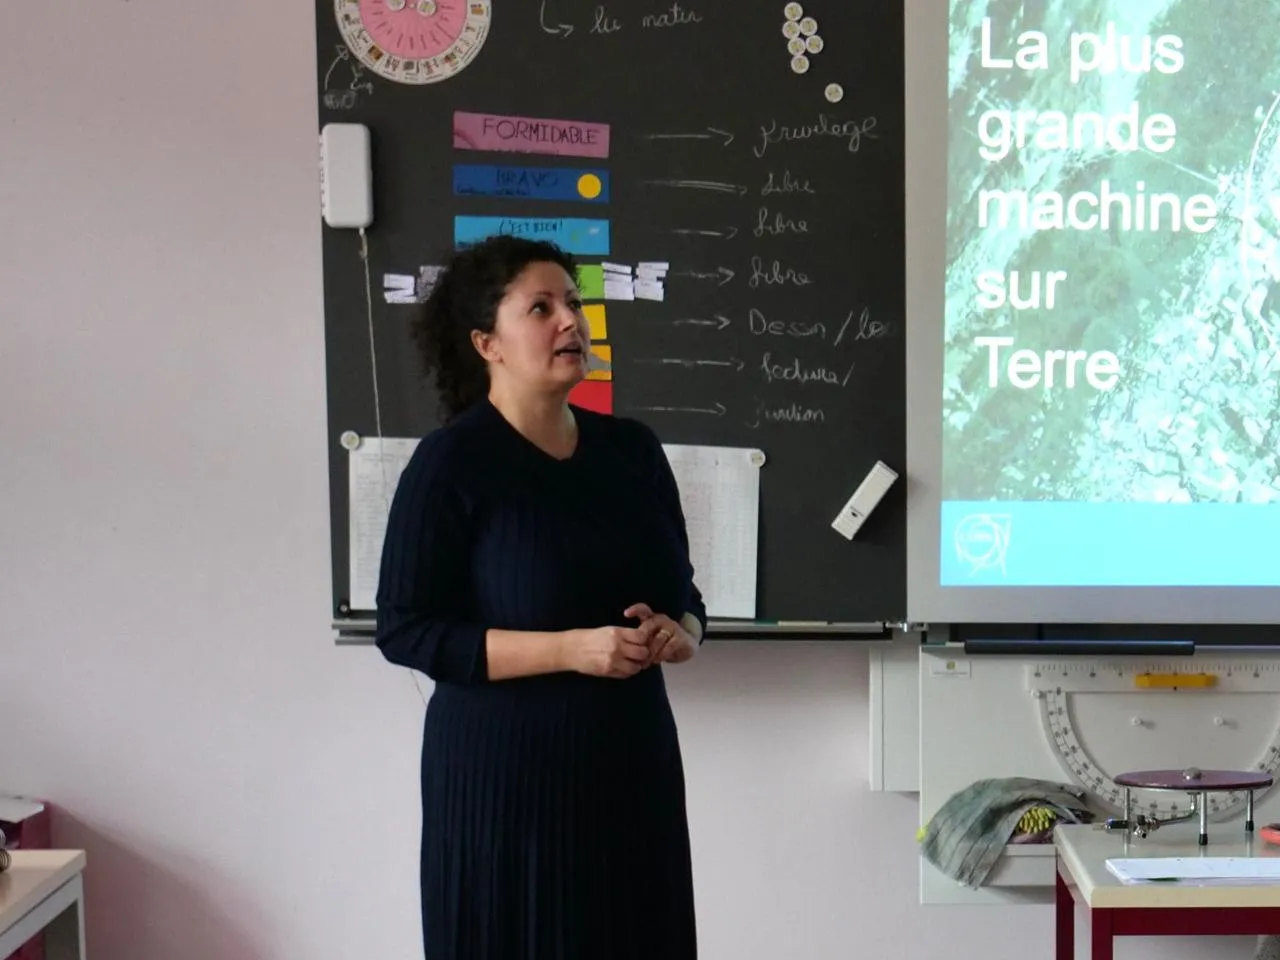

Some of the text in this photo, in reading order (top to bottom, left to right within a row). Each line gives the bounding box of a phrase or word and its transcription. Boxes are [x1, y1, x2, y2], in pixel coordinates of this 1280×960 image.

[981, 16, 1185, 84] La plus
[482, 118, 600, 145] FORMIDABLE
[977, 100, 1177, 162] grande
[496, 168, 559, 188] BRAVO
[978, 179, 1217, 233] machine
[976, 270, 1068, 310] sur
[974, 336, 1121, 390] Terre
